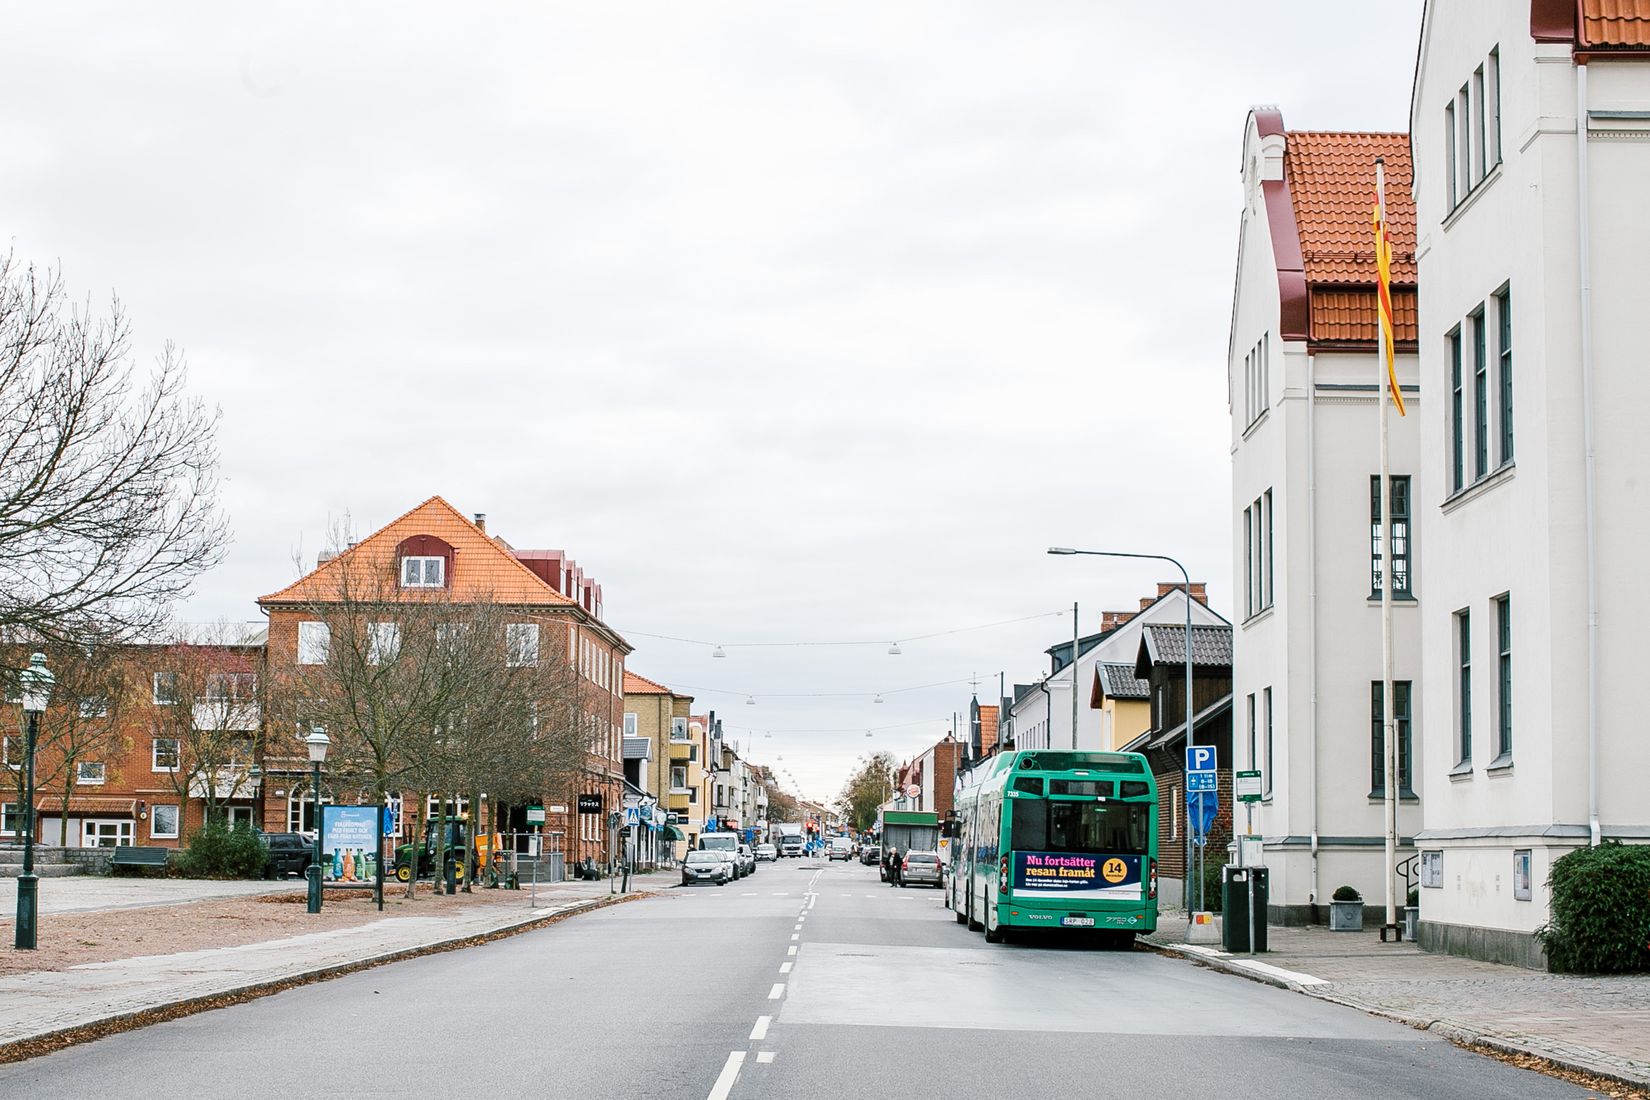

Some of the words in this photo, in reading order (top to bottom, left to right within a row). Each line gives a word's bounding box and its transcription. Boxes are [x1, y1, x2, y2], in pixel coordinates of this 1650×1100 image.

[1195, 749, 1210, 769] P
[1026, 856, 1042, 865] Nu
[1044, 856, 1095, 867] fortsätter
[1026, 867, 1056, 876] resan
[1059, 866, 1095, 878] framåt
[1108, 863, 1122, 873] 14
